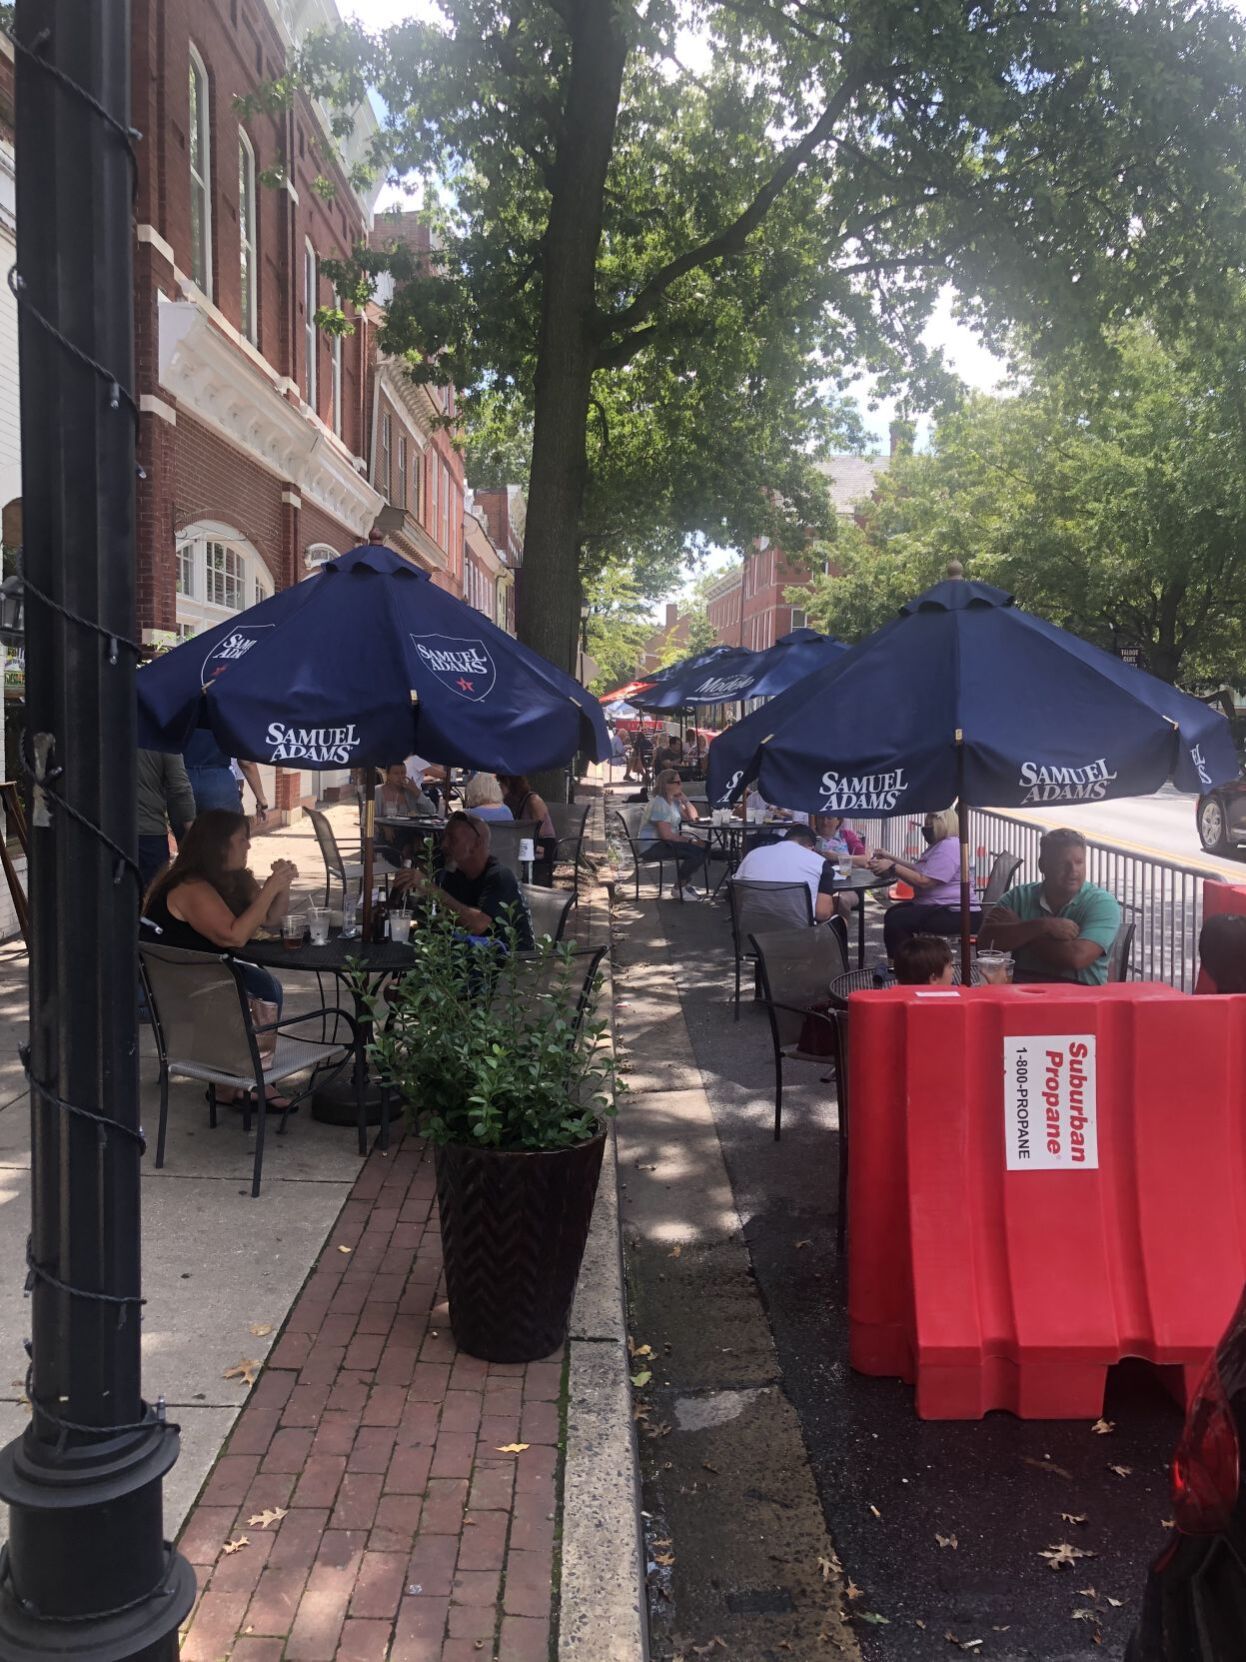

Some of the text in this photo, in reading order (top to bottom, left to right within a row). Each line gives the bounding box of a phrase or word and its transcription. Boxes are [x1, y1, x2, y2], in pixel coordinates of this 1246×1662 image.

[417, 644, 487, 663] SAMUEL
[431, 658, 488, 674] ADAMS
[265, 722, 360, 746] SAMUEL
[270, 744, 350, 764] ADAMS
[819, 768, 908, 795] SAMUEL
[1019, 758, 1117, 787] SAMUEL
[819, 791, 899, 812] ADAMS
[1020, 780, 1108, 805] ADAMS
[1016, 1047, 1030, 1159] 1-800-PROPANE
[1042, 1050, 1063, 1155] Propane
[1069, 1042, 1088, 1162] Suburban
